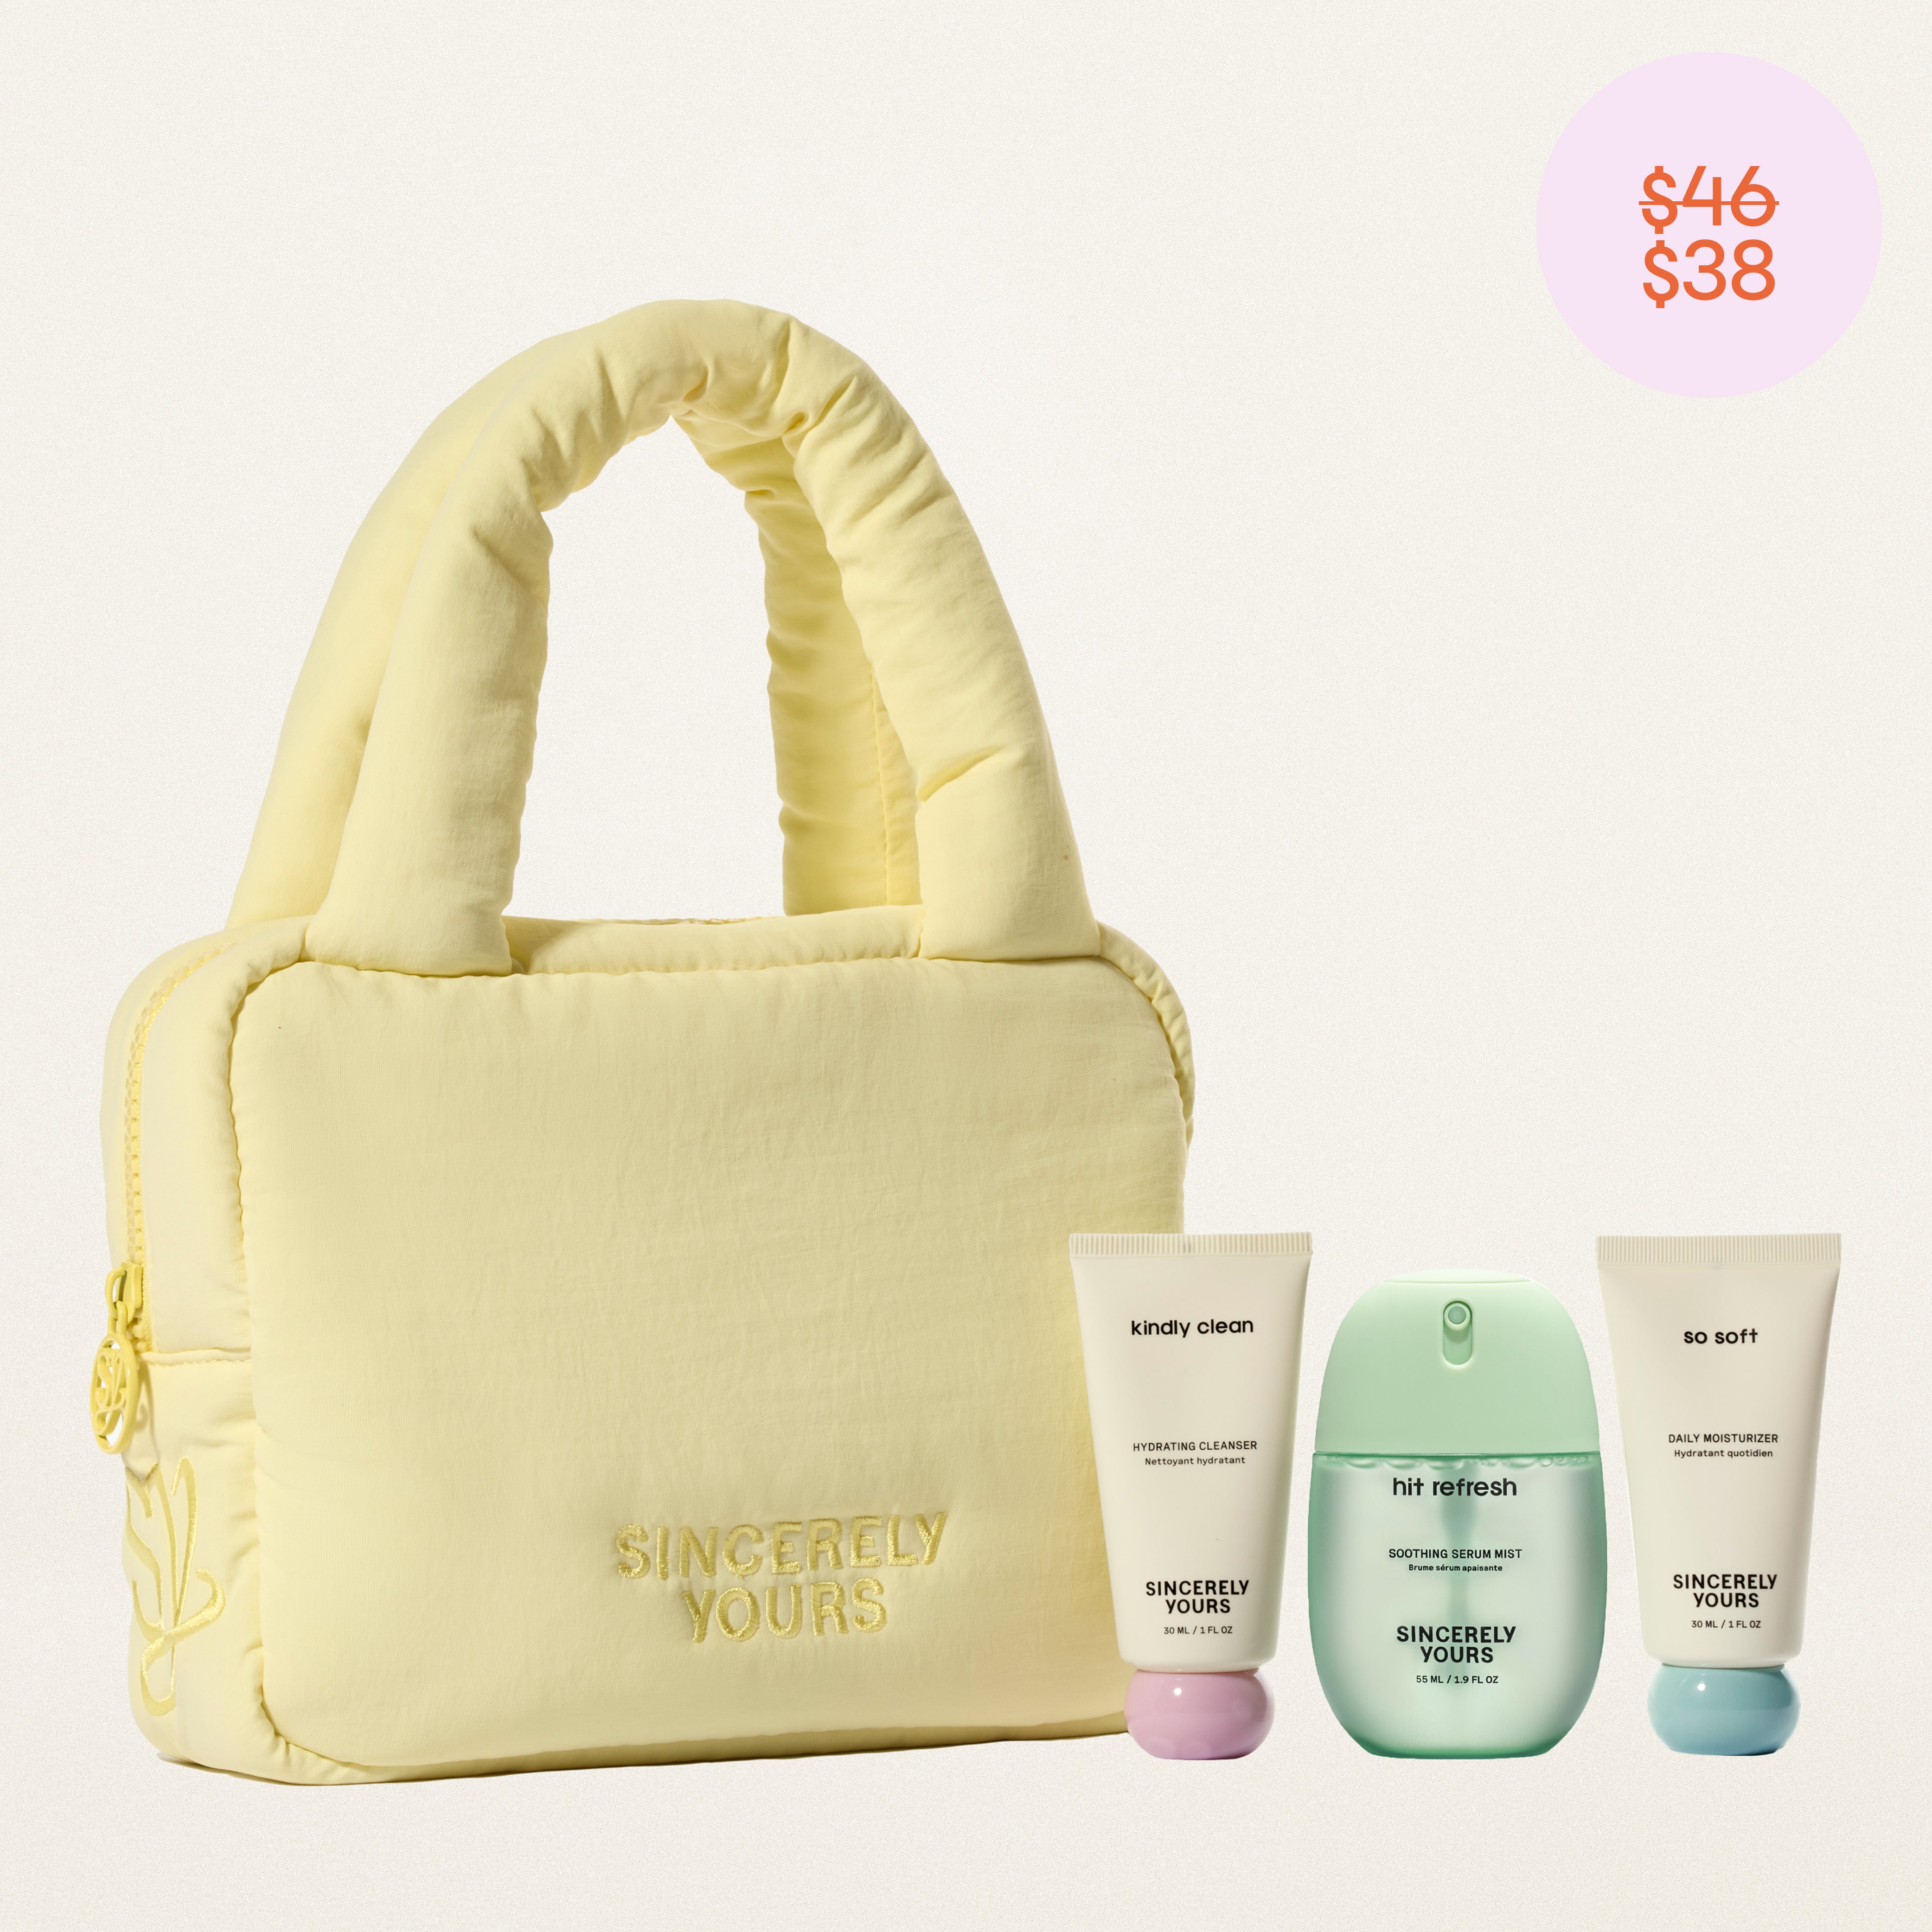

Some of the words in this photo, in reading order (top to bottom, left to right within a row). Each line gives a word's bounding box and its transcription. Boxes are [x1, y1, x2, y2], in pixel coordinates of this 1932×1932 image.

[1131, 1319, 1191, 1338] kindly
[1197, 1318, 1254, 1335] clean
[1683, 1331, 1708, 1344] so
[1714, 1328, 1758, 1344] soft
[1133, 1442, 1196, 1452] HYDRATING
[1199, 1440, 1257, 1451] CLEANSER
[1669, 1433, 1700, 1443] DAILY
[1703, 1433, 1778, 1443] MOISTURIZER
[1145, 1458, 1194, 1466] Nettoyant
[1197, 1456, 1246, 1466] hydratant
[1674, 1449, 1725, 1459] Hydratant
[1727, 1449, 1773, 1459] quotidien
[1393, 1477, 1424, 1496] hit
[1433, 1478, 1517, 1497] refresh
[615, 1511, 947, 1580] SINCERELY
[1388, 1548, 1448, 1559] SOOTHING
[1452, 1549, 1491, 1559] SERUM
[1494, 1548, 1523, 1559] MIST
[1462, 1564, 1503, 1573] apaisante
[1145, 1580, 1249, 1596] SINCERELY
[1673, 1574, 1778, 1590] SINCERELY
[1165, 1598, 1231, 1614] YOURS
[1693, 1592, 1759, 1608] YOURS
[681, 1577, 887, 1644] YOURS
[1164, 1626, 1175, 1635] 30
[1192, 1625, 1197, 1635] /
[1221, 1626, 1233, 1634] OZ
[1691, 1620, 1703, 1628] 30
[1705, 1620, 1718, 1628] ML
[1721, 1619, 1726, 1629] /
[1736, 1620, 1747, 1628] FL
[1749, 1620, 1761, 1628] OZ
[1396, 1625, 1516, 1643] SINCERELY
[1420, 1646, 1494, 1663] YOURS
[1416, 1675, 1428, 1683] 55
[1430, 1675, 1444, 1683] ML
[1446, 1675, 1452, 1684] /
[1454, 1676, 1469, 1684] 1.9
[1471, 1676, 1484, 1684] FL
[1485, 1676, 1499, 1684] OZ
